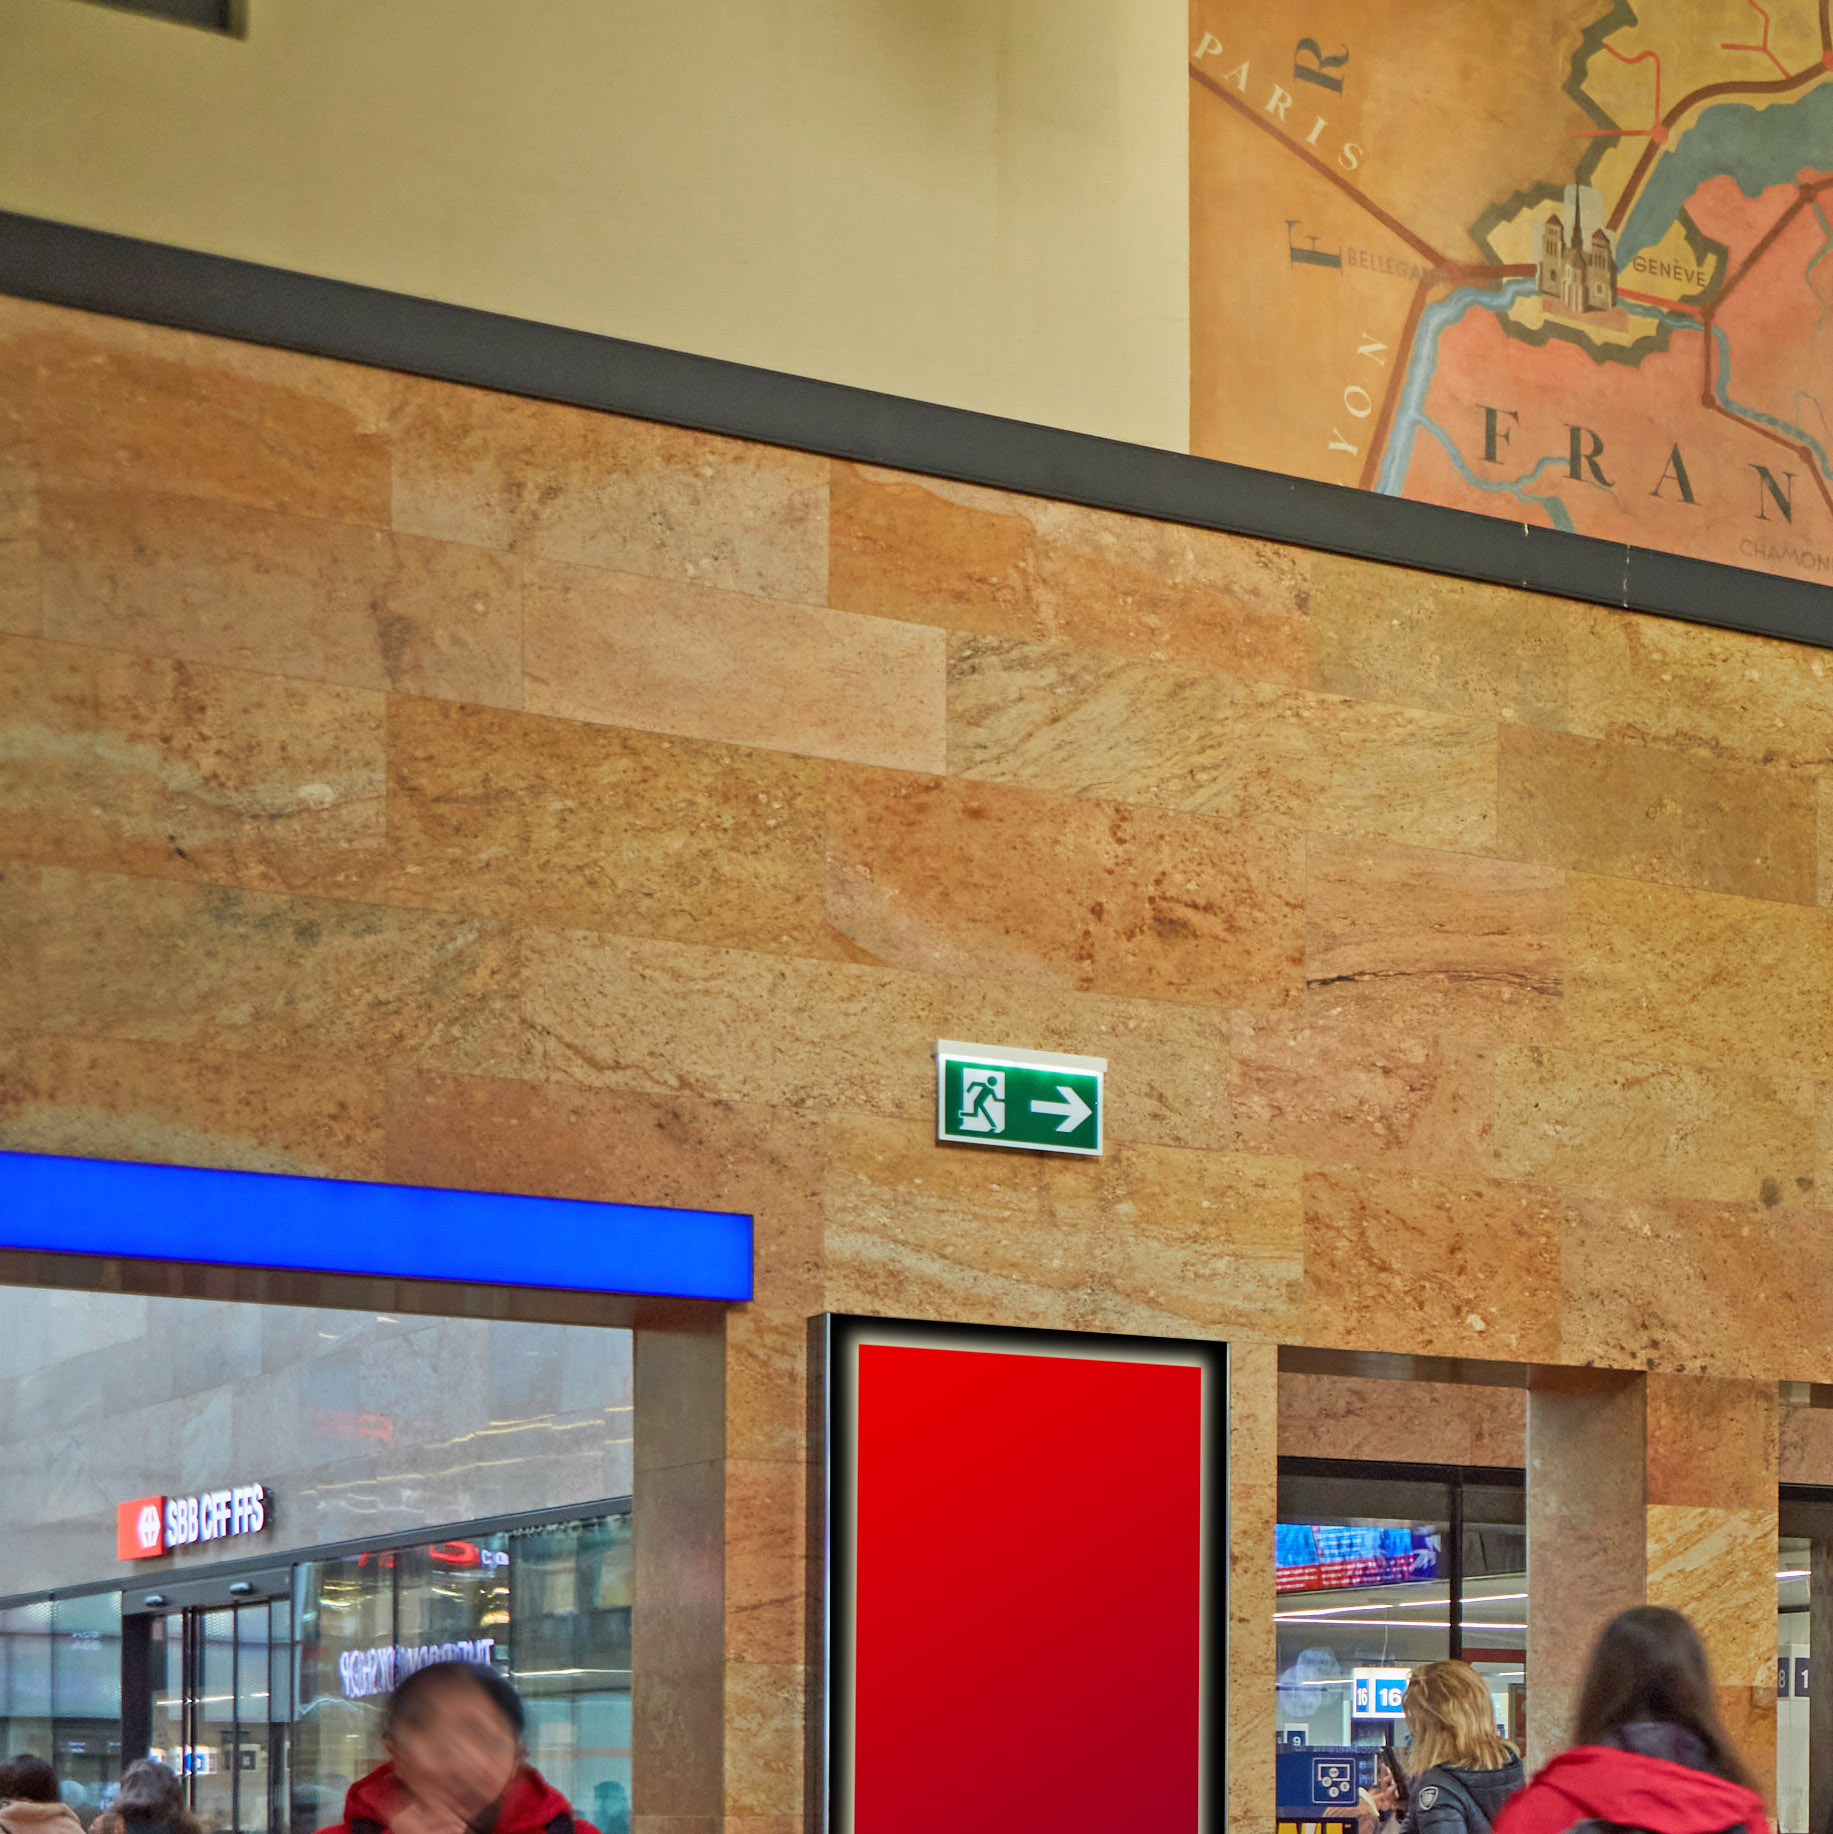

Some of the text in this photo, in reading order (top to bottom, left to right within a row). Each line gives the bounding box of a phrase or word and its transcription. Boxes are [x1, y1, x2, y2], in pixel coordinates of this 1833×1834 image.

[1193, 30, 1364, 172] PARIS
[1632, 258, 1708, 288] GENÈVE
[1328, 331, 1389, 486] YON
[166, 1482, 265, 1548] SBB CFF FFS
[1356, 1687, 1369, 1706] 16
[1378, 1687, 1402, 1707] 16
